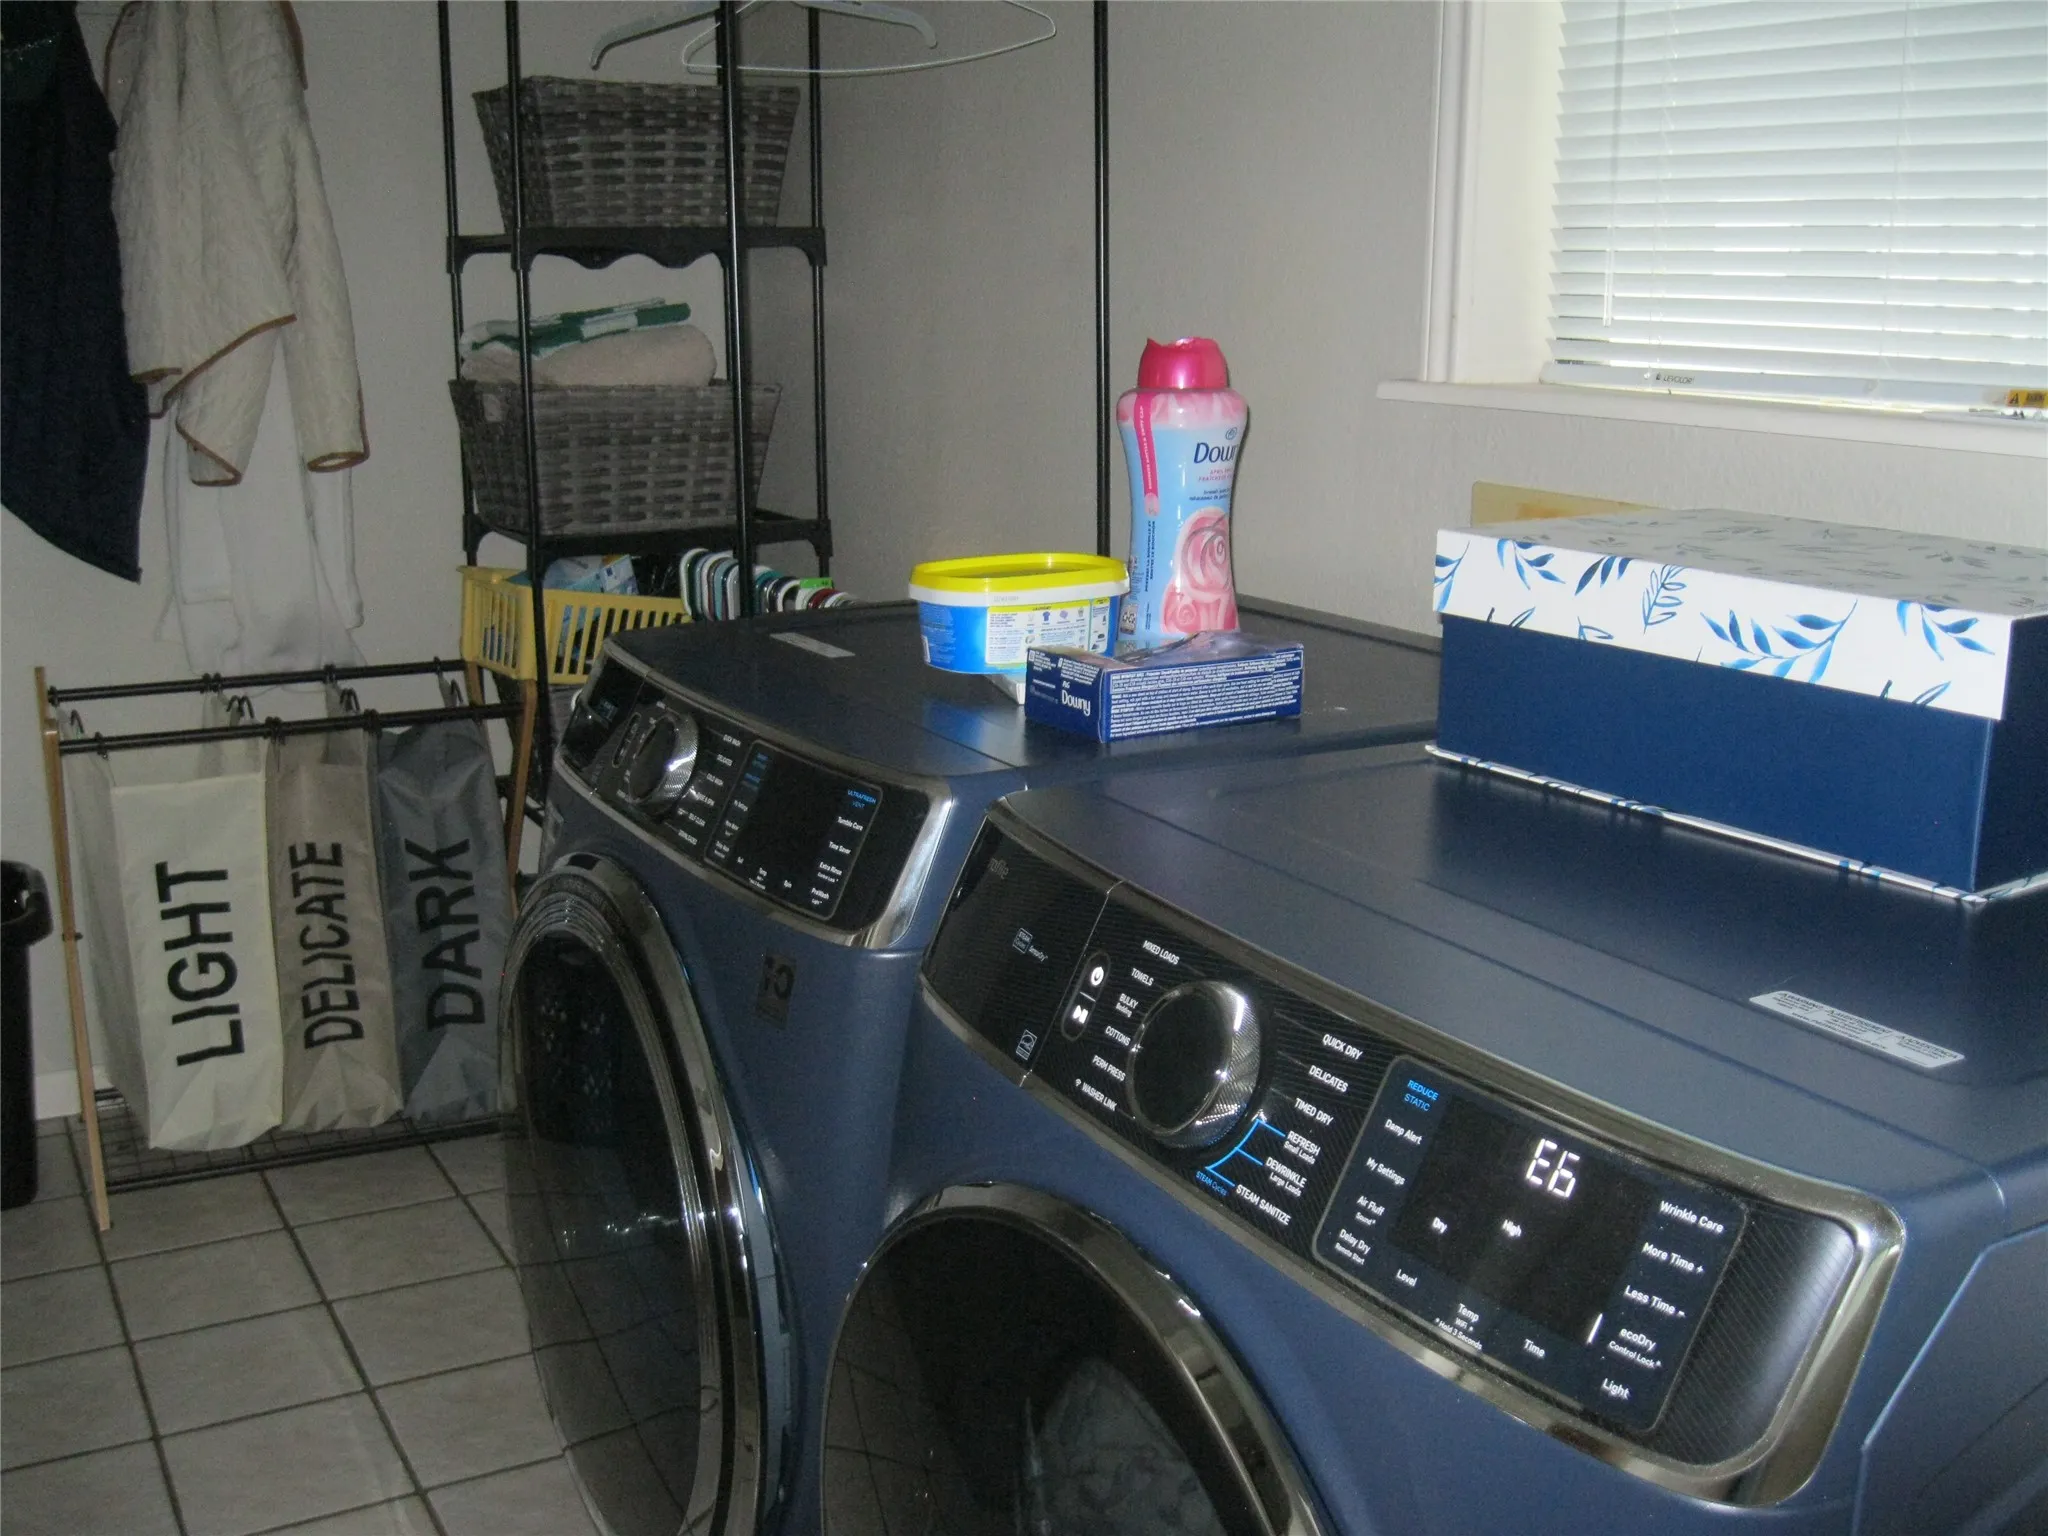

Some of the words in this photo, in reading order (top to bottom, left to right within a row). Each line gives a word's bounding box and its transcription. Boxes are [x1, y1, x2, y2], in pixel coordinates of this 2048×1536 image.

[1062, 689, 1091, 717] Downy
[289, 842, 364, 1050] DELICATE
[404, 838, 486, 1032] DARK
[155, 861, 245, 1067] LIGHT
[1142, 940, 1161, 955] MIXED
[1159, 948, 1180, 965] LOADS
[1131, 967, 1154, 986] TOWELS
[1119, 993, 1138, 1009] BULKY
[1105, 1025, 1131, 1047] COTTONS
[1322, 1033, 1346, 1053] QUICK
[1344, 1045, 1363, 1060] DRY
[1092, 1054, 1109, 1070] PERM
[1106, 1064, 1126, 1081] PRESS
[1308, 1064, 1349, 1093] DELICATES
[1081, 1082, 1105, 1103] WASHER
[1103, 1096, 1117, 1112] LINK
[1404, 1093, 1430, 1112] STATIC
[1407, 1079, 1439, 1101] REDUCE
[1294, 1097, 1317, 1117] TIMED
[1315, 1110, 1334, 1126] DRY
[1287, 1130, 1321, 1157] REFRESH
[1384, 1118, 1405, 1136] Damp
[1403, 1129, 1423, 1145] Alert
[1195, 1170, 1213, 1186] STEAM
[1265, 1156, 1307, 1188] DEWRINKLE
[1366, 1157, 1378, 1170] My
[1377, 1163, 1405, 1185] Settings
[1525, 1138, 1581, 1199] E6
[1236, 1184, 1260, 1206] STEAM
[1259, 1199, 1292, 1226] SANITIZE
[1356, 1195, 1369, 1207] Air
[1367, 1200, 1386, 1216] Fluff
[1659, 1200, 1698, 1224] Wrinkle
[1698, 1215, 1724, 1234] Care
[1432, 1216, 1448, 1234] Dry
[1502, 1218, 1522, 1238] High
[1339, 1228, 1358, 1247] Delay
[1357, 1239, 1371, 1255] Dry
[1642, 1242, 1668, 1263] More
[1669, 1253, 1695, 1272] Time
[1396, 1268, 1418, 1287] Level
[1458, 1303, 1479, 1322] Temp
[1625, 1285, 1649, 1304] Less
[1649, 1296, 1675, 1315] Time
[1439, 1320, 1453, 1334] Hold
[1452, 1328, 1458, 1336] 3
[1457, 1331, 1482, 1350] Seconds
[1523, 1338, 1546, 1358] Time
[1620, 1328, 1656, 1352] ecoDry
[1608, 1340, 1637, 1359] Control
[1636, 1353, 1655, 1368] Lock
[1602, 1378, 1629, 1400] Light
